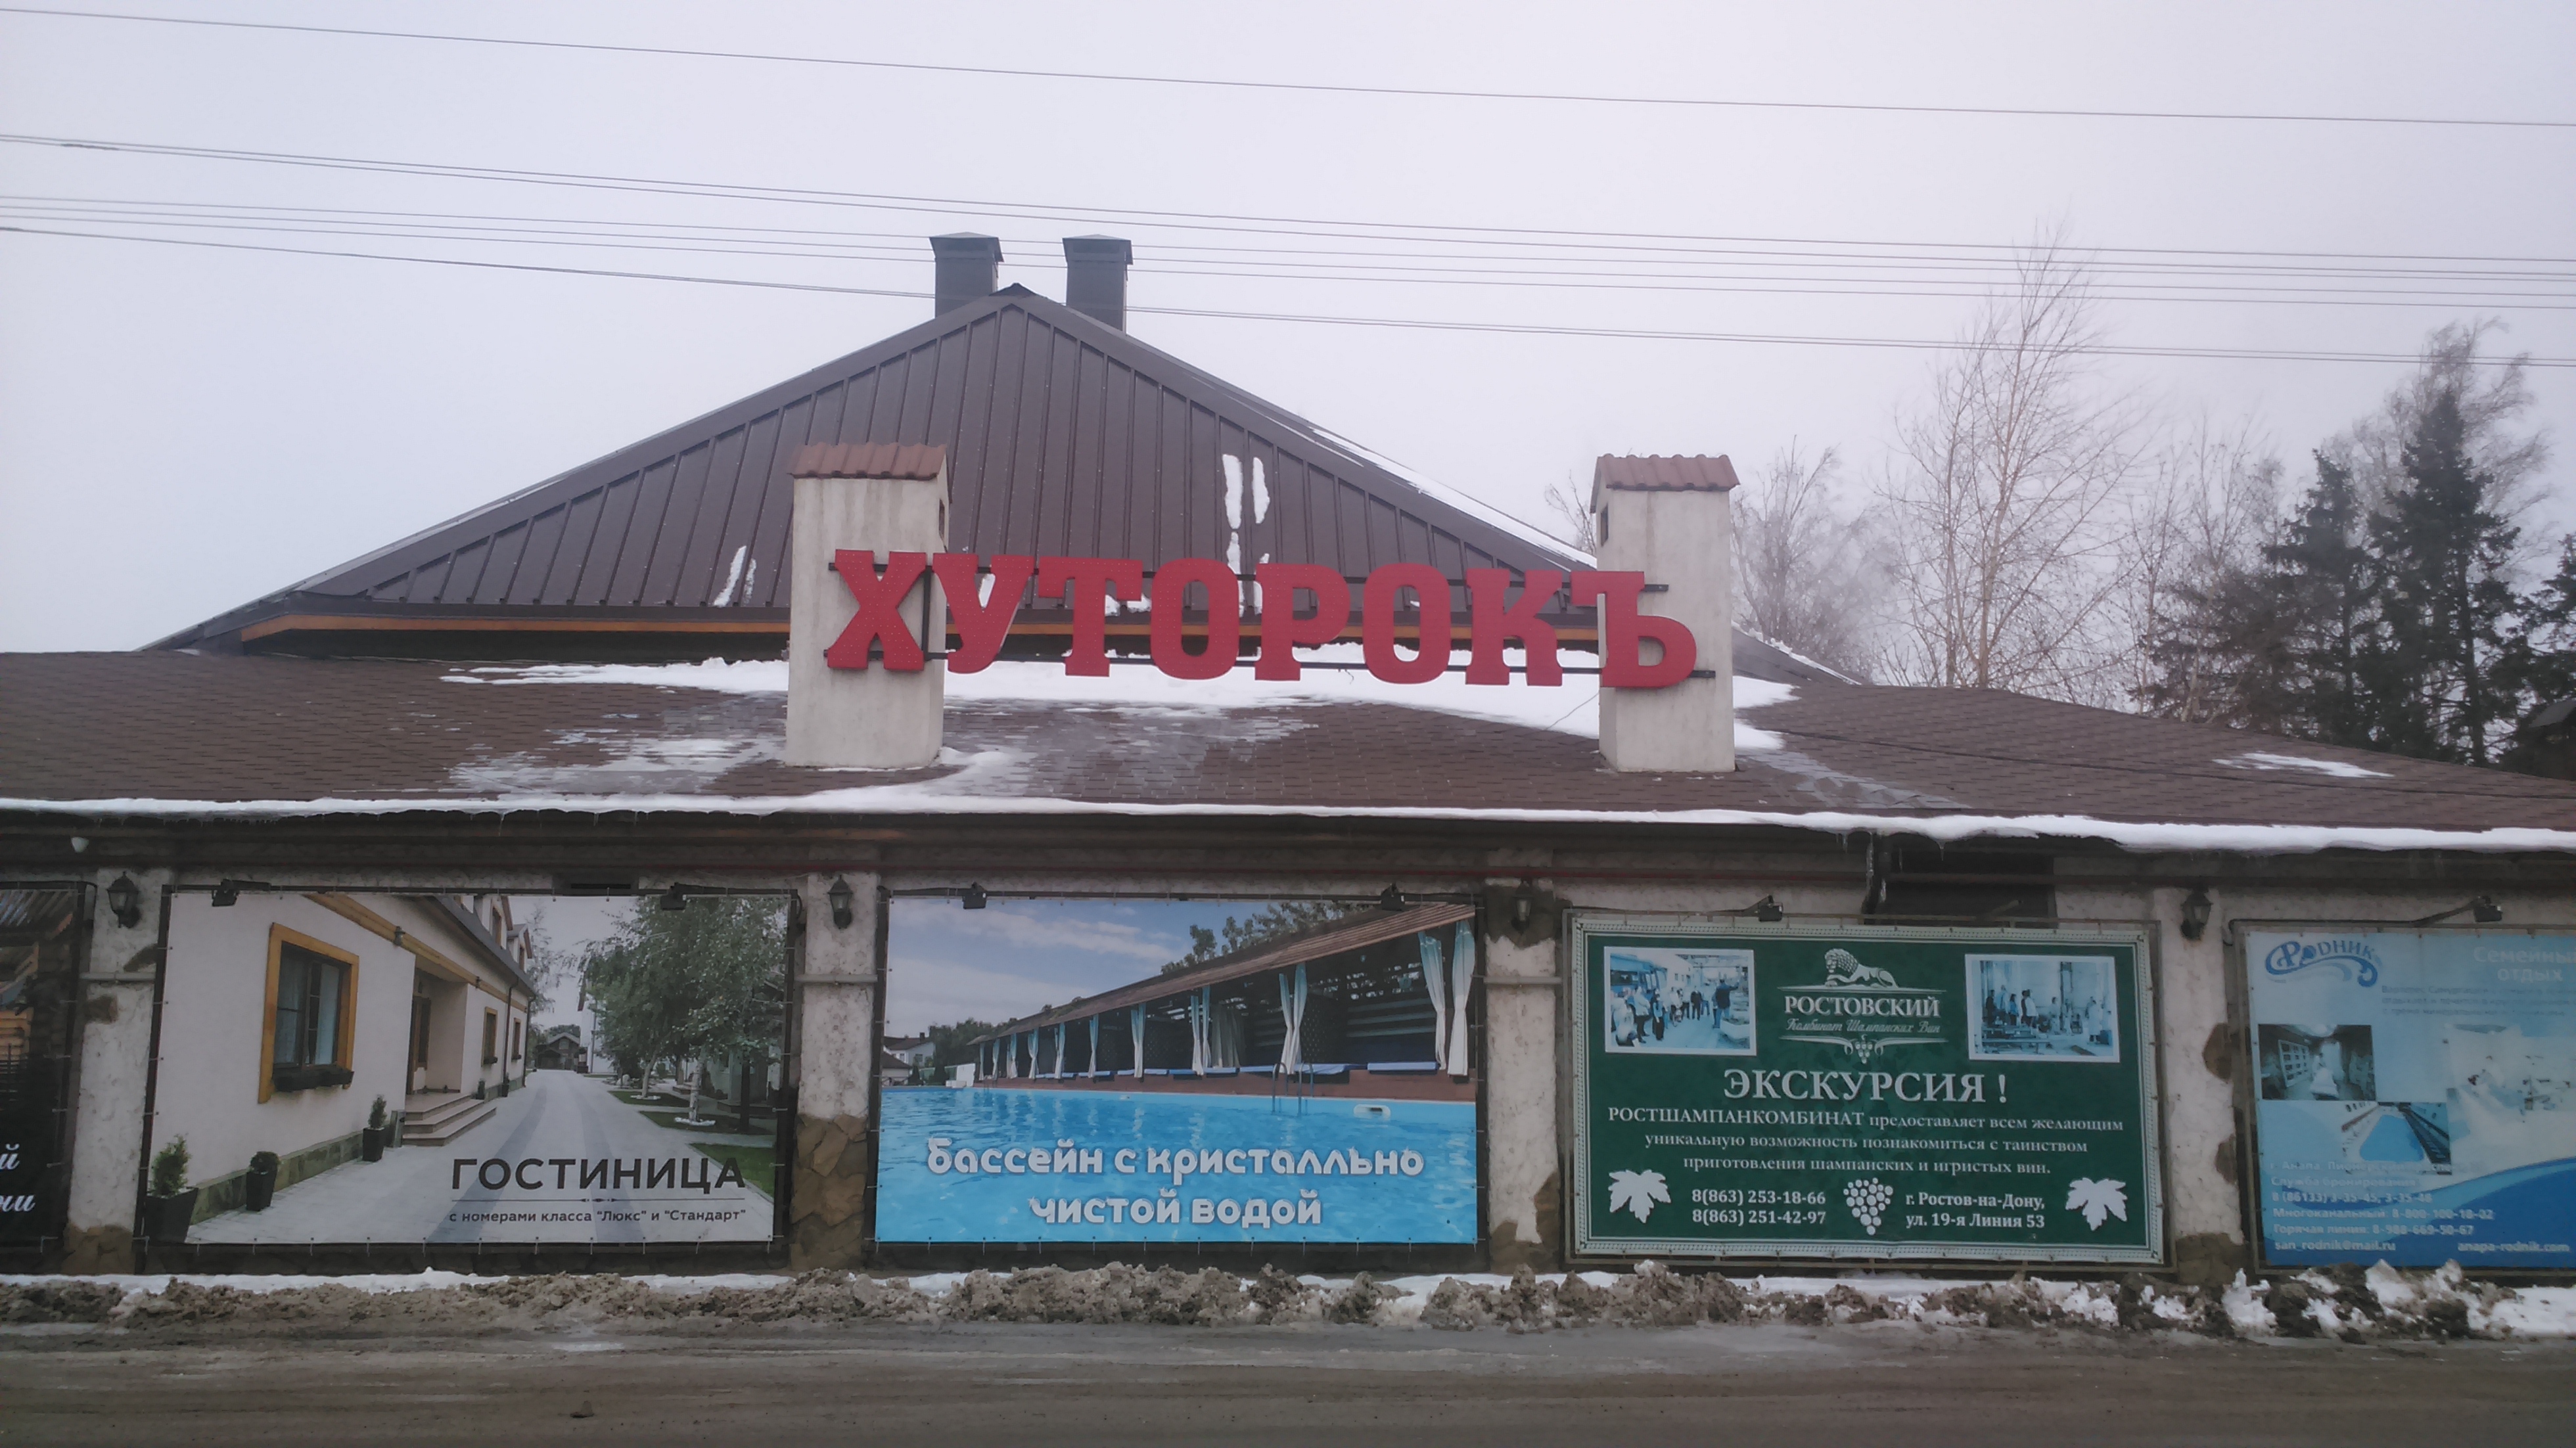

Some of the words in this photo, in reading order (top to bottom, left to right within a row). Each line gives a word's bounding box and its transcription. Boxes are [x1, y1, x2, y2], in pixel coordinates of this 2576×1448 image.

[825, 548, 1697, 688] ХУТОРОКЪ
[2473, 945, 2576, 964] Семейны
[1784, 995, 1941, 1018] РОСТОВСКИЙ
[1786, 1018, 1843, 1032] Комбинат
[1846, 1019, 1914, 1033] Шампанских
[1918, 1020, 1941, 1033] Вин
[1607, 1106, 1865, 1126] РОСТШАМПАНКОМБИНАТ
[1870, 1116, 1985, 1131] предоставляет
[1990, 1119, 2027, 1129] всем
[2033, 1119, 2124, 1132] желающим
[1645, 1134, 1745, 1150] уникальную
[1749, 1136, 1858, 1148] возможность
[1862, 1139, 1985, 1150] познакомиться
[1990, 1141, 1998, 1150] с
[2002, 1141, 2088, 1152] таинством
[927, 1137, 1103, 1174] бассейн
[1114, 1147, 1138, 1174] с
[1146, 1145, 1425, 1185] кристалльно
[1683, 1156, 1806, 1172] приготовления
[1810, 1159, 1914, 1171] шампанских
[1918, 1161, 1929, 1171] и
[1933, 1162, 2012, 1176] игристых
[2016, 1163, 2051, 1175] вин.
[451, 1157, 746, 1195] ГОСТИНИЦА
[1691, 1189, 1744, 1205] 8(863)
[1748, 1190, 1826, 1205] 253-18-66
[1906, 1195, 1915, 1206] г.
[1918, 1191, 2045, 1210] Ростов-на-Дону,
[449, 1212, 457, 1221] с
[462, 1211, 536, 1223] номерами
[541, 1211, 591, 1222] класса
[651, 1212, 660, 1221] и
[1029, 1187, 1181, 1224] чистой
[1191, 1188, 1323, 1229] водой
[1692, 1209, 1744, 1225] 8(863)
[1748, 1210, 1826, 1225] 251-42-97
[1906, 1216, 1928, 1229] ул.
[1932, 1212, 1966, 1227] 19-я
[1970, 1214, 2023, 1229] Линия
[2026, 1215, 2045, 1229] 53
